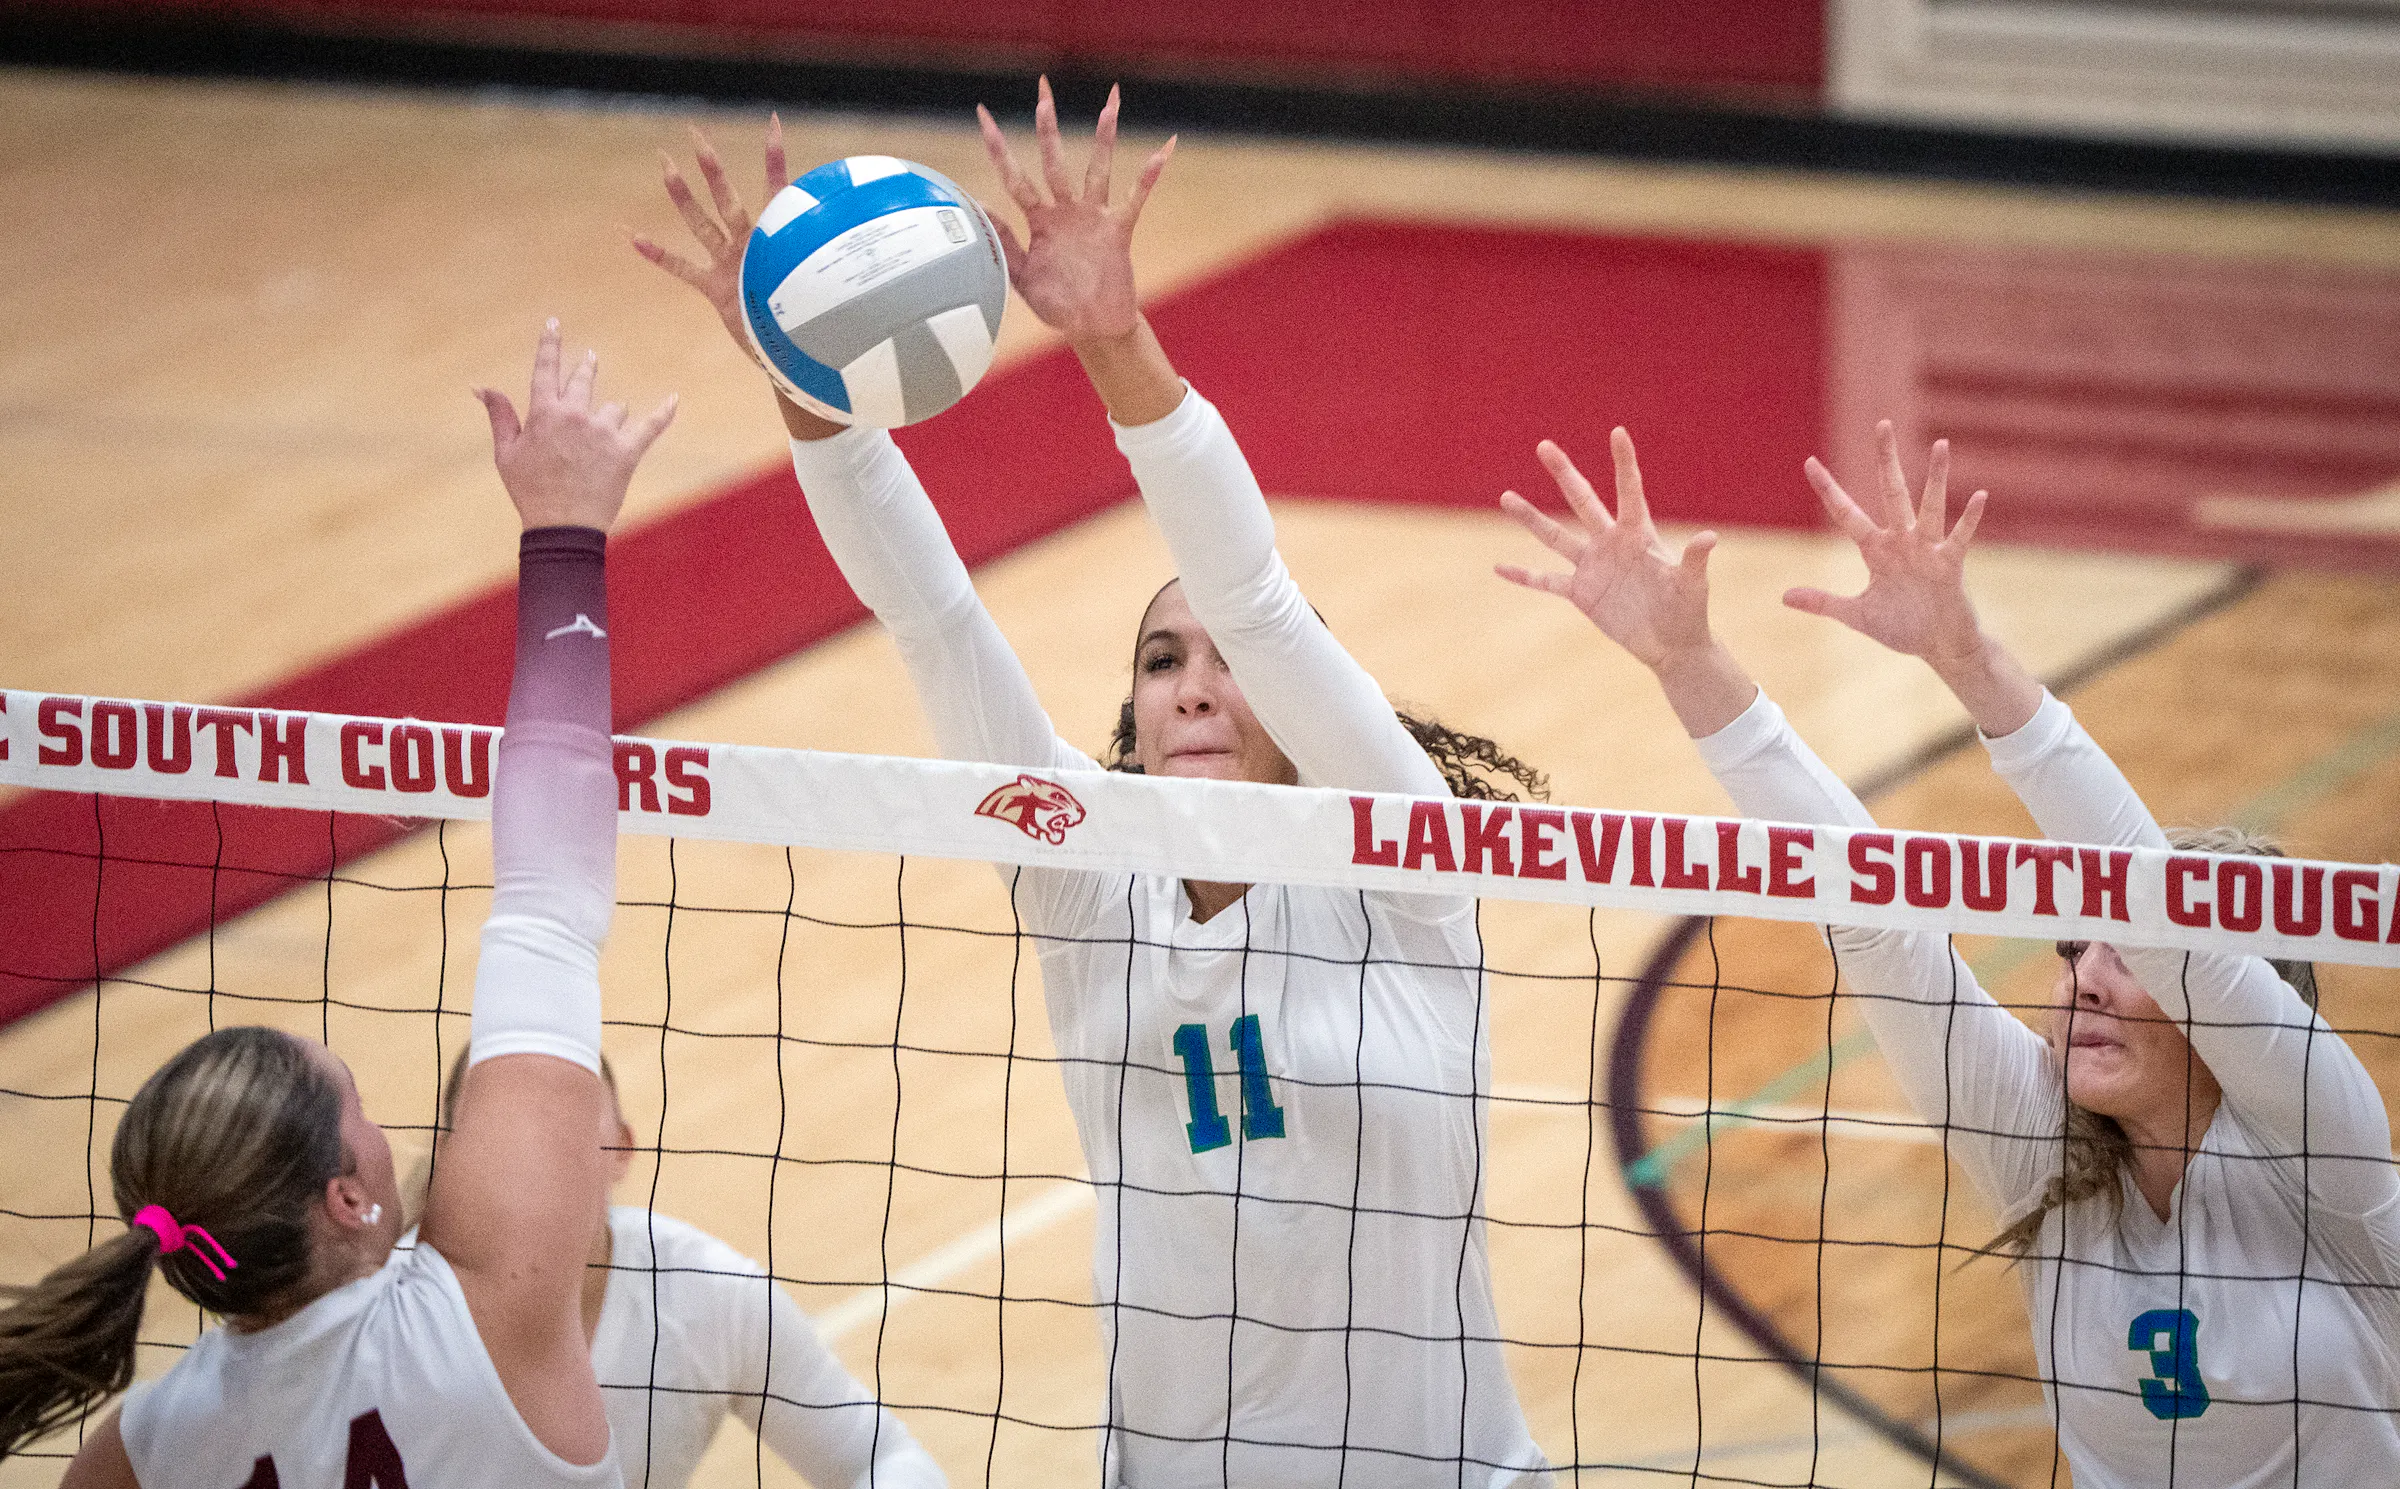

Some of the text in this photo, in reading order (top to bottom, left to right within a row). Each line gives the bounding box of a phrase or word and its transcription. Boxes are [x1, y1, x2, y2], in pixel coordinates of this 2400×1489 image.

[38, 697, 310, 785] SOUTH
[340, 720, 711, 816] COURS
[1349, 796, 2400, 944] LAKEVILLE SOUTH COUG
[1173, 1013, 1286, 1154] 11
[2128, 1309, 2211, 1420] 3
